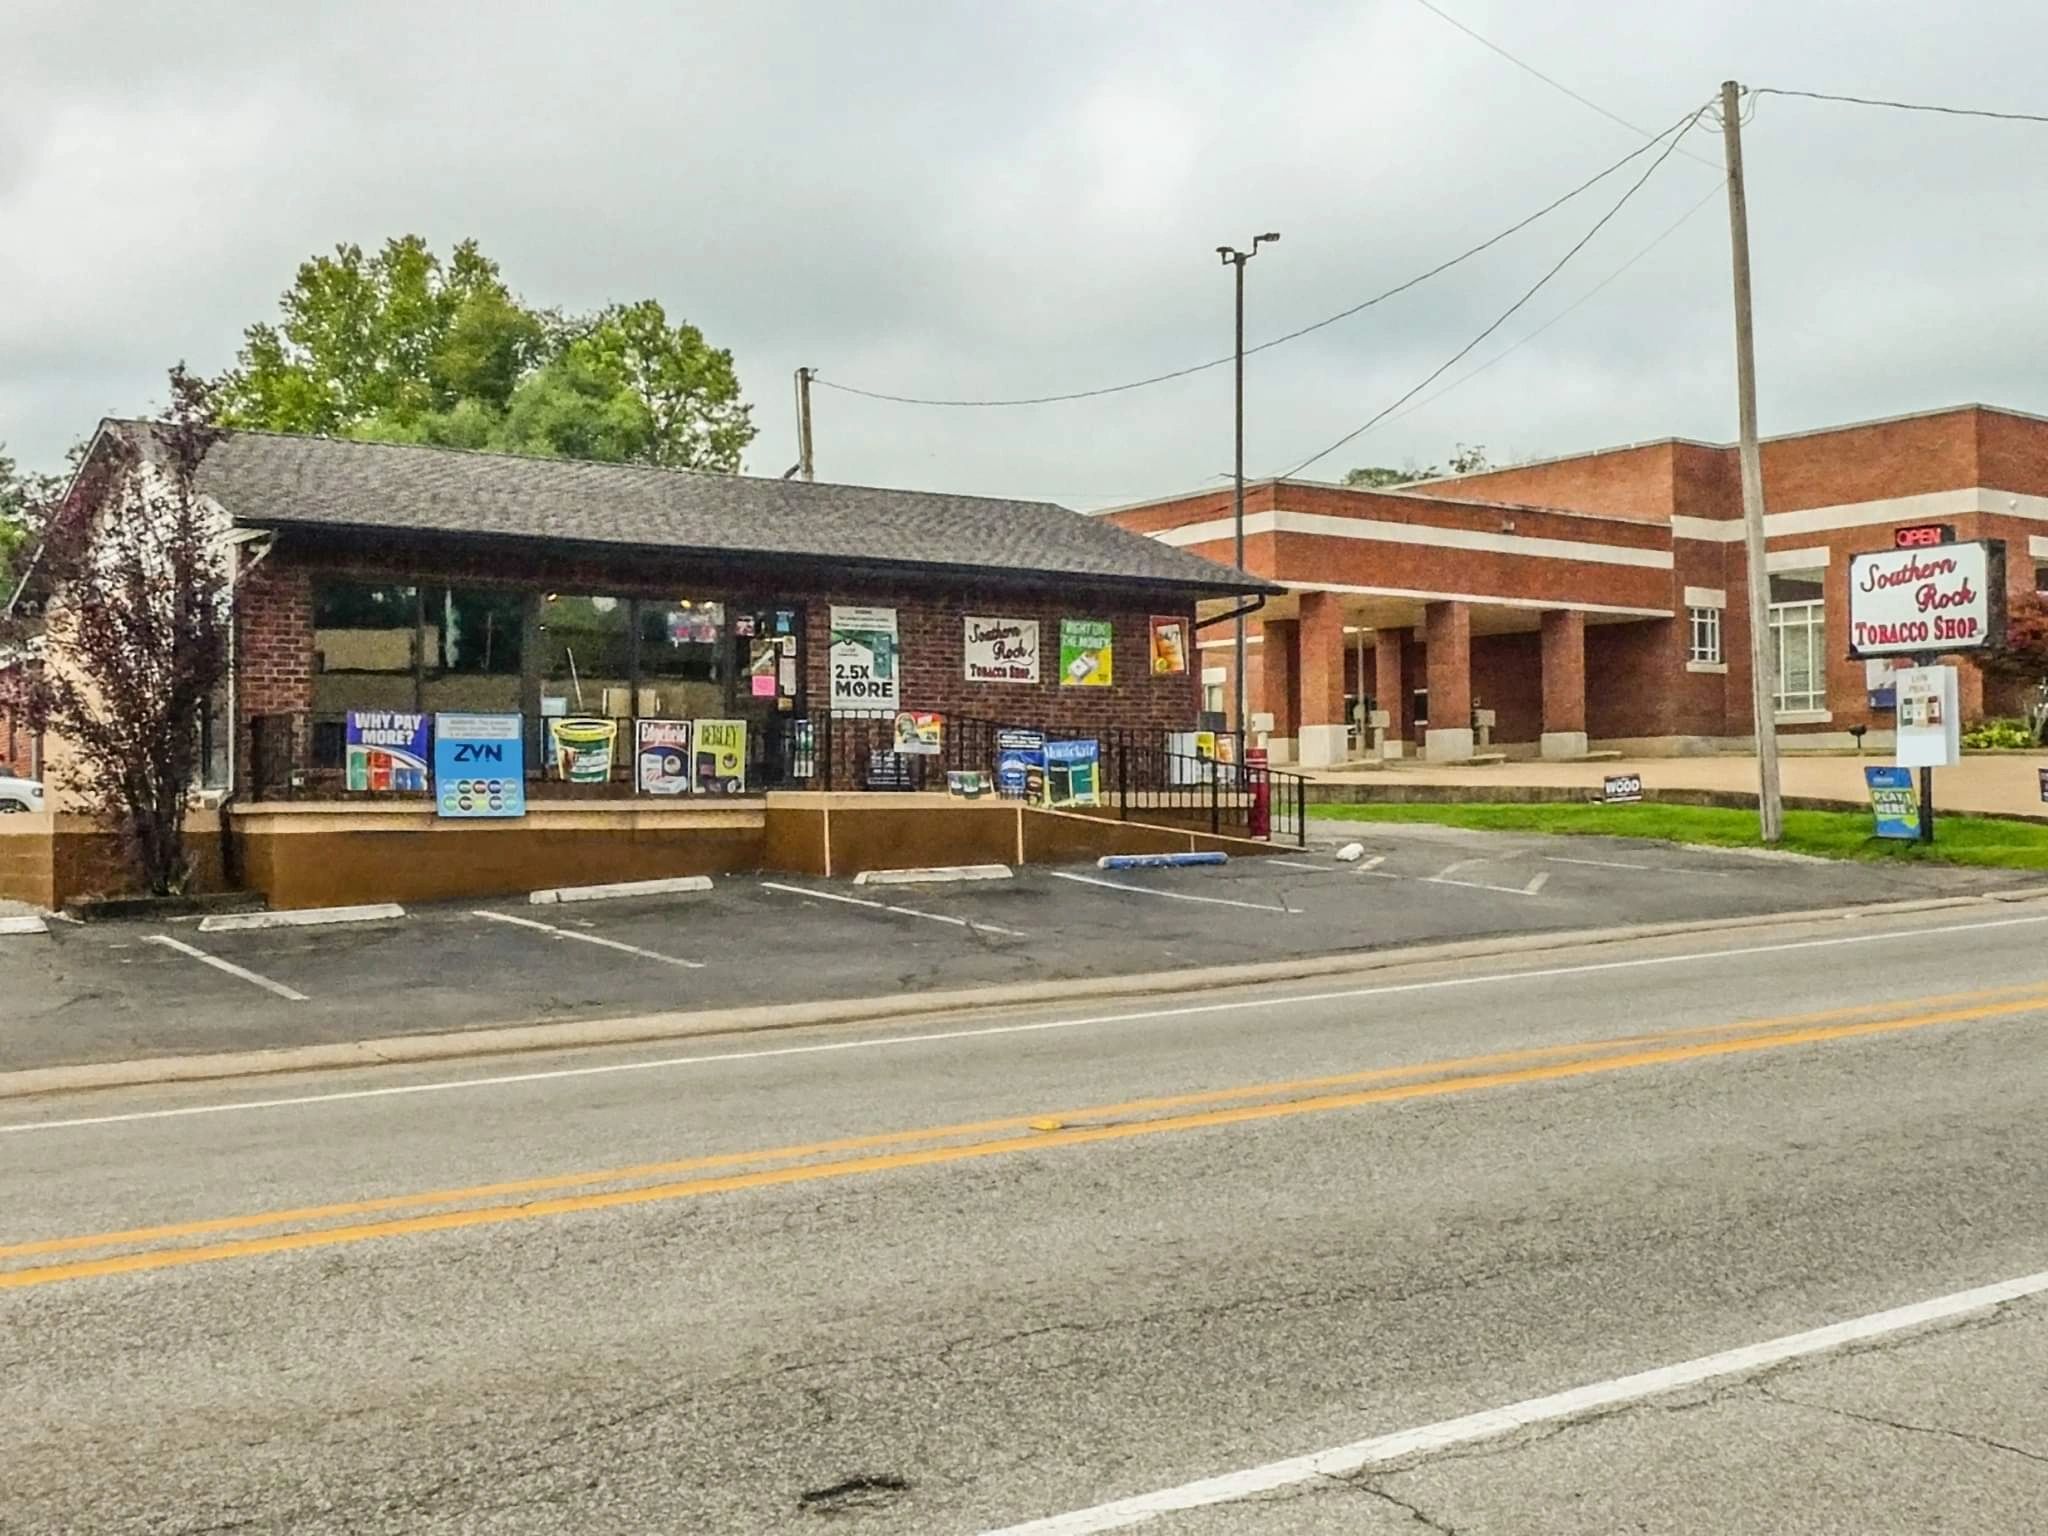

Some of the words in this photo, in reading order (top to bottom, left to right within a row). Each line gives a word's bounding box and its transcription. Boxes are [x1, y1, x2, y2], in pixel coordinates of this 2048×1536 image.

[1896, 527, 1942, 546] OPEN
[1860, 554, 1957, 592] Southern
[1915, 577, 1977, 613] Rock
[968, 619, 1021, 643] Southern
[1855, 621, 1928, 646] TOBACCO
[1934, 615, 1977, 640] SHOP
[992, 639, 1026, 660] Rock
[835, 664, 869, 679] 2.5X
[835, 681, 893, 698] MORE
[355, 712, 394, 730] WHY
[395, 714, 422, 731] PAY
[362, 730, 414, 745] MORE?
[454, 744, 502, 762] ZYN
[1605, 779, 1640, 794] WOOD
